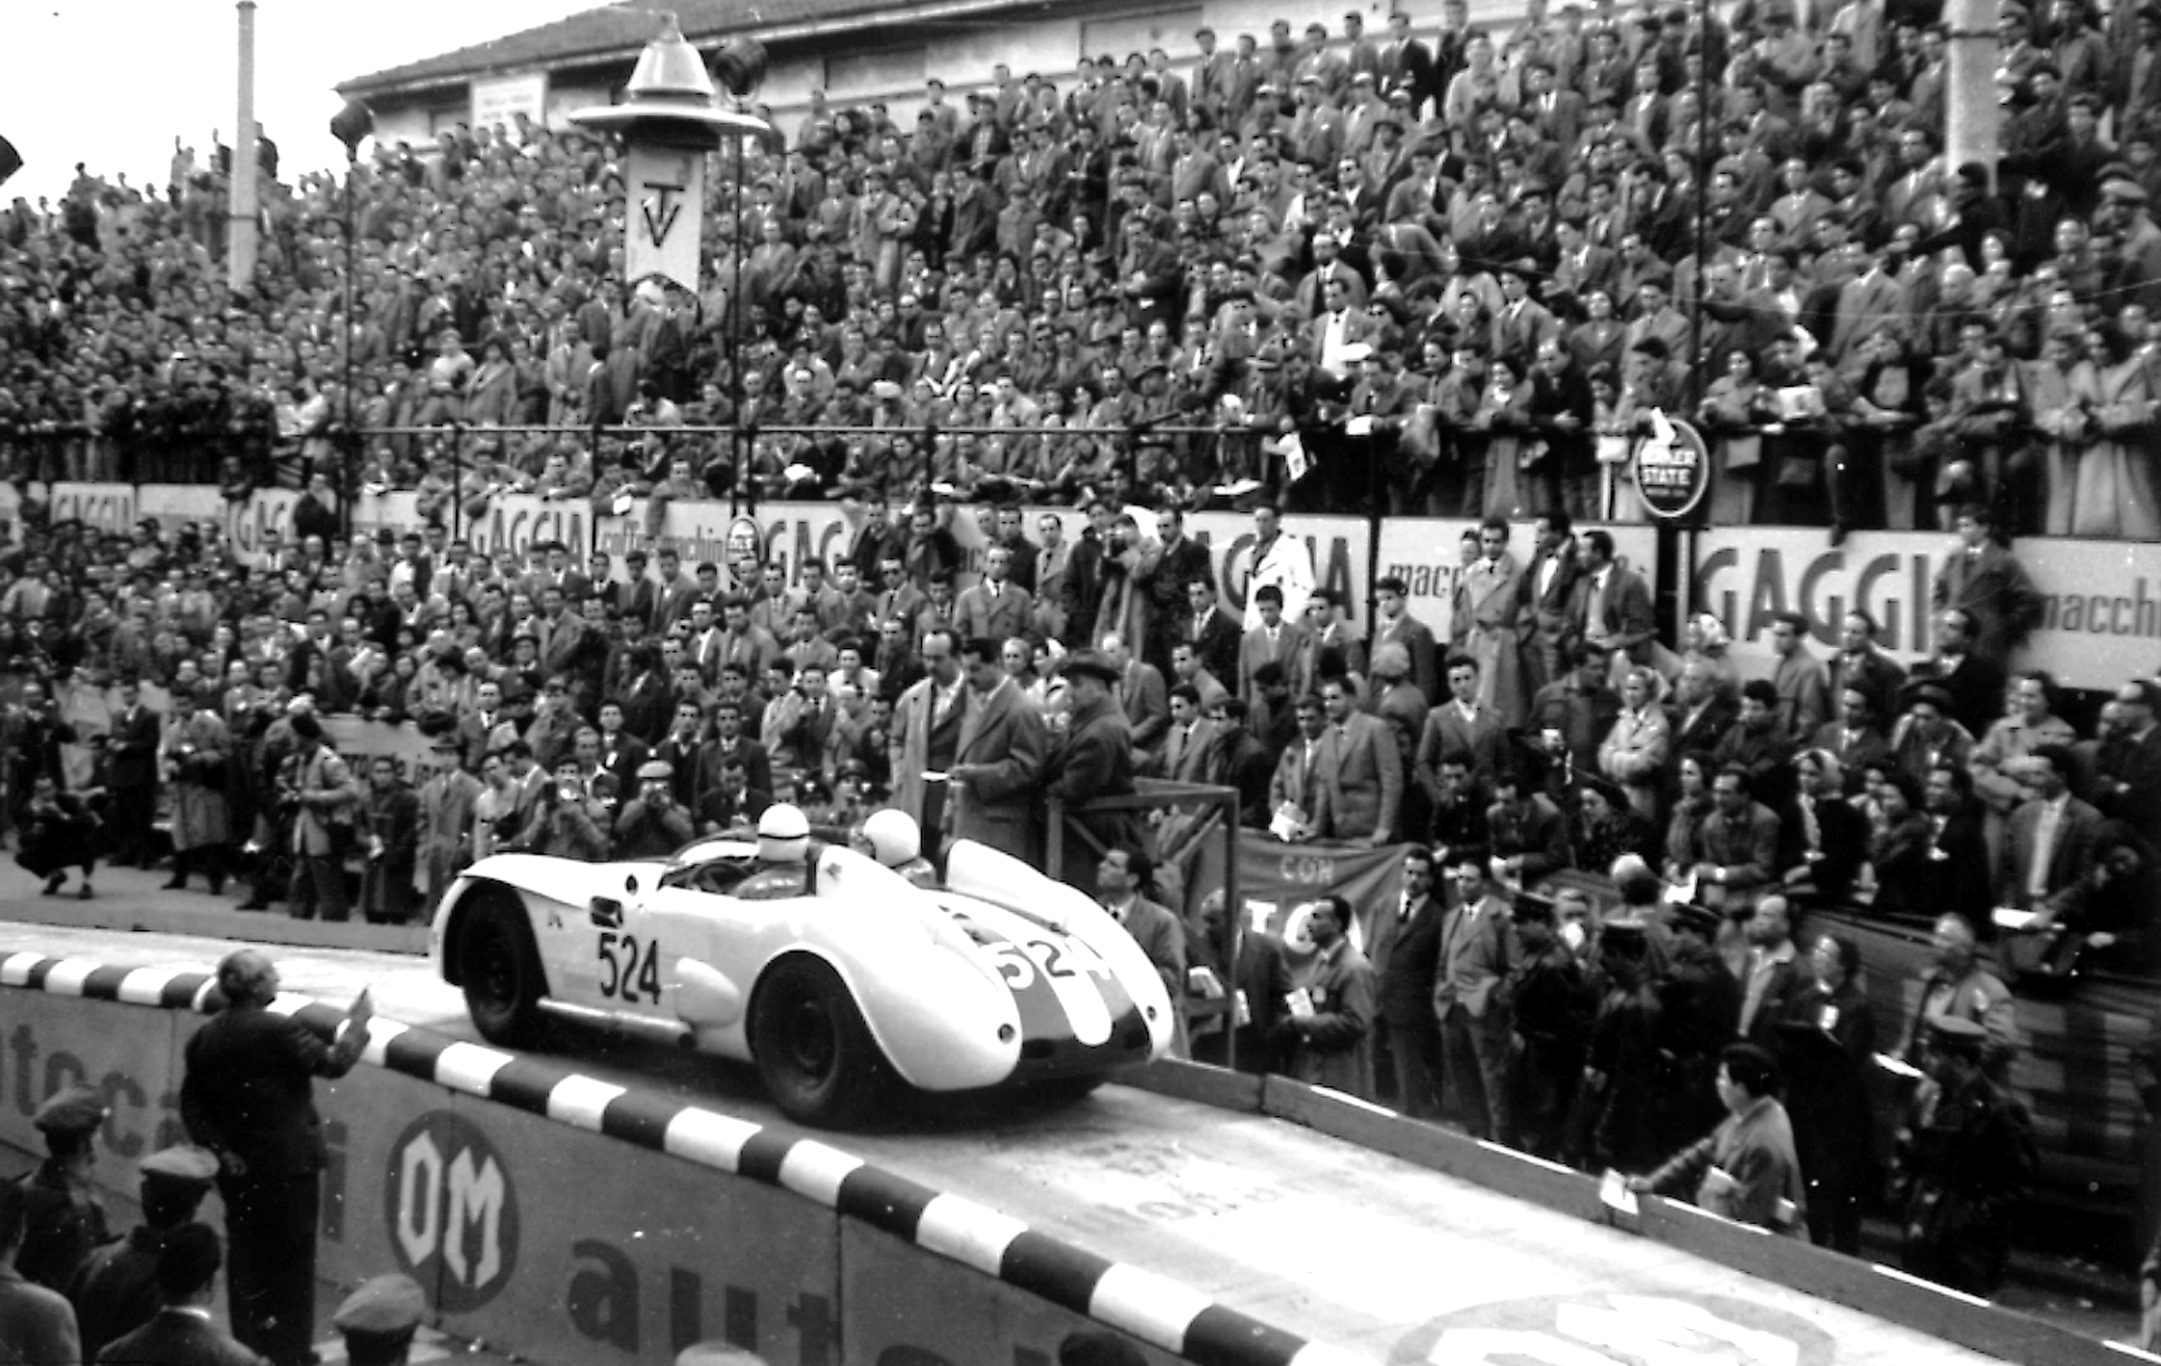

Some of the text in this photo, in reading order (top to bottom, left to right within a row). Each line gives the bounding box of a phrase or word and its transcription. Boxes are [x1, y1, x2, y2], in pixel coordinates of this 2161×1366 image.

[1642, 468, 1691, 484] STATE
[1695, 548, 1930, 653] GAGGI
[598, 931, 662, 1006] 524
[397, 1129, 503, 1289] OM
